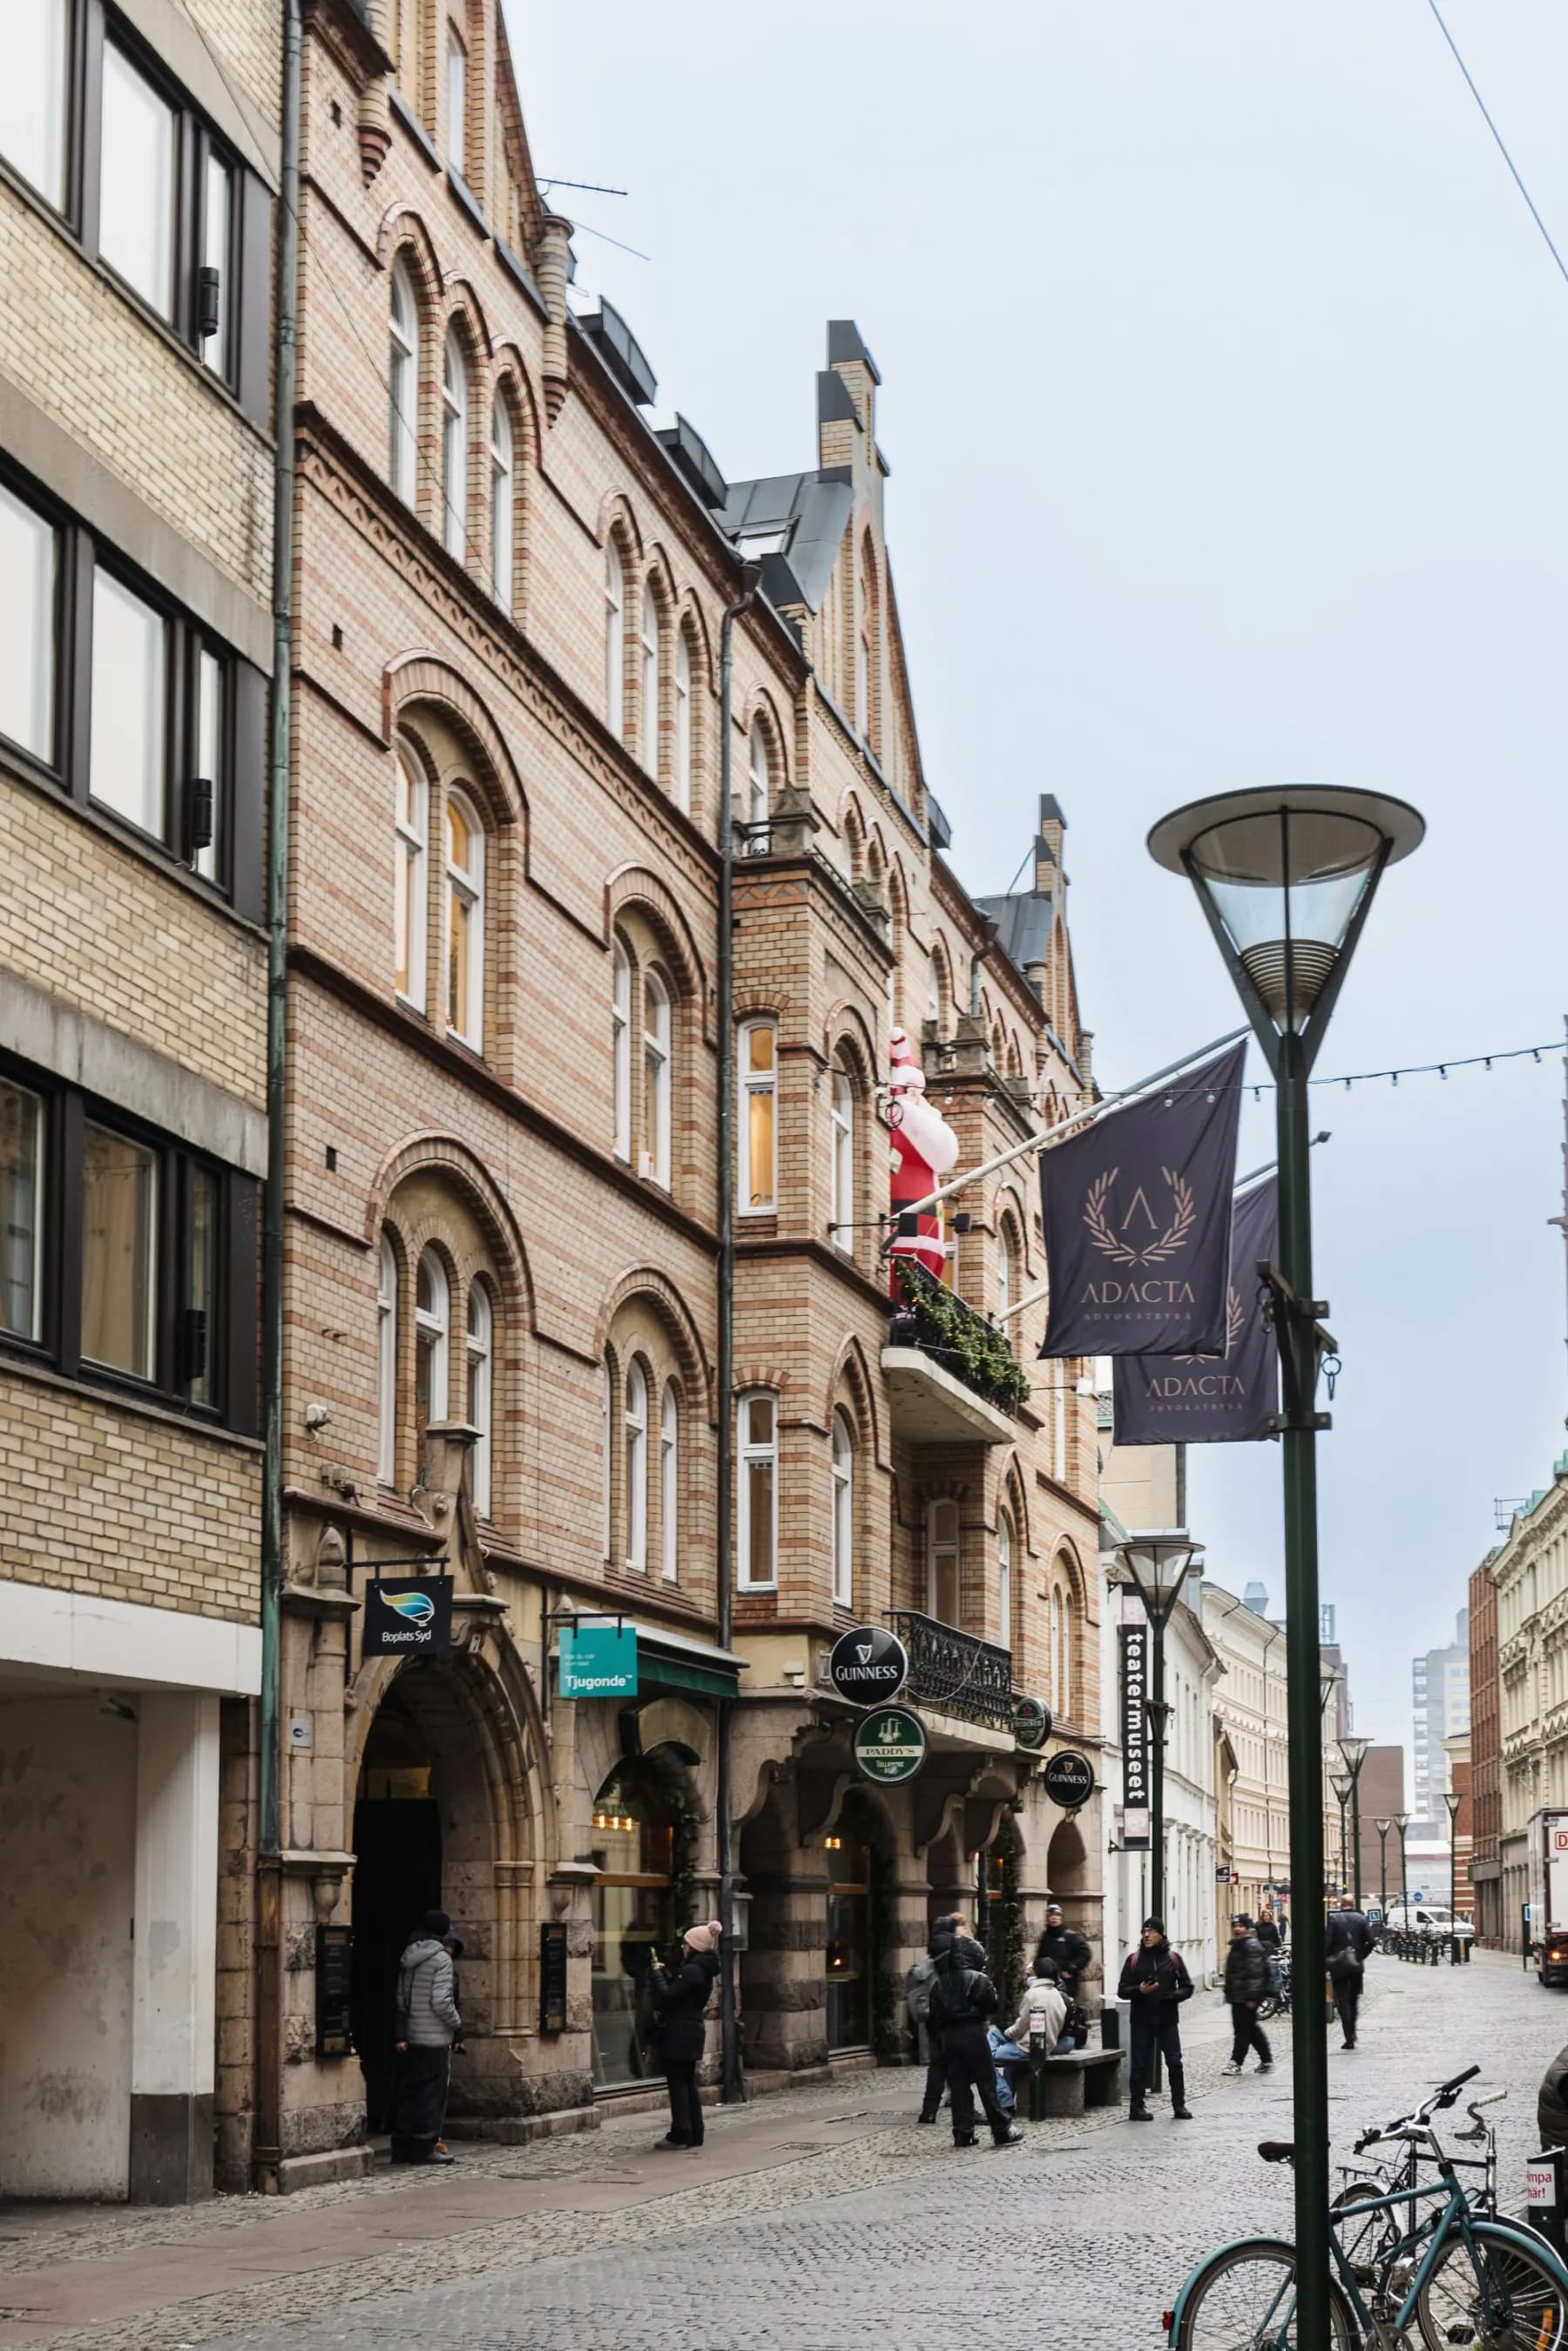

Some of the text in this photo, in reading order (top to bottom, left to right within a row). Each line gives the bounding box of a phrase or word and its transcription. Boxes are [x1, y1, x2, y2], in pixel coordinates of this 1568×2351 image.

[1080, 1280, 1196, 1303] ADACTA
[1146, 1375, 1246, 1397] ADACTA
[382, 1630, 432, 1644] Boplats Syd
[835, 1665, 898, 1681] GUINNESS
[1126, 1632, 1146, 1800] teatermuseet
[1048, 1772, 1088, 1785] GUINNESS
